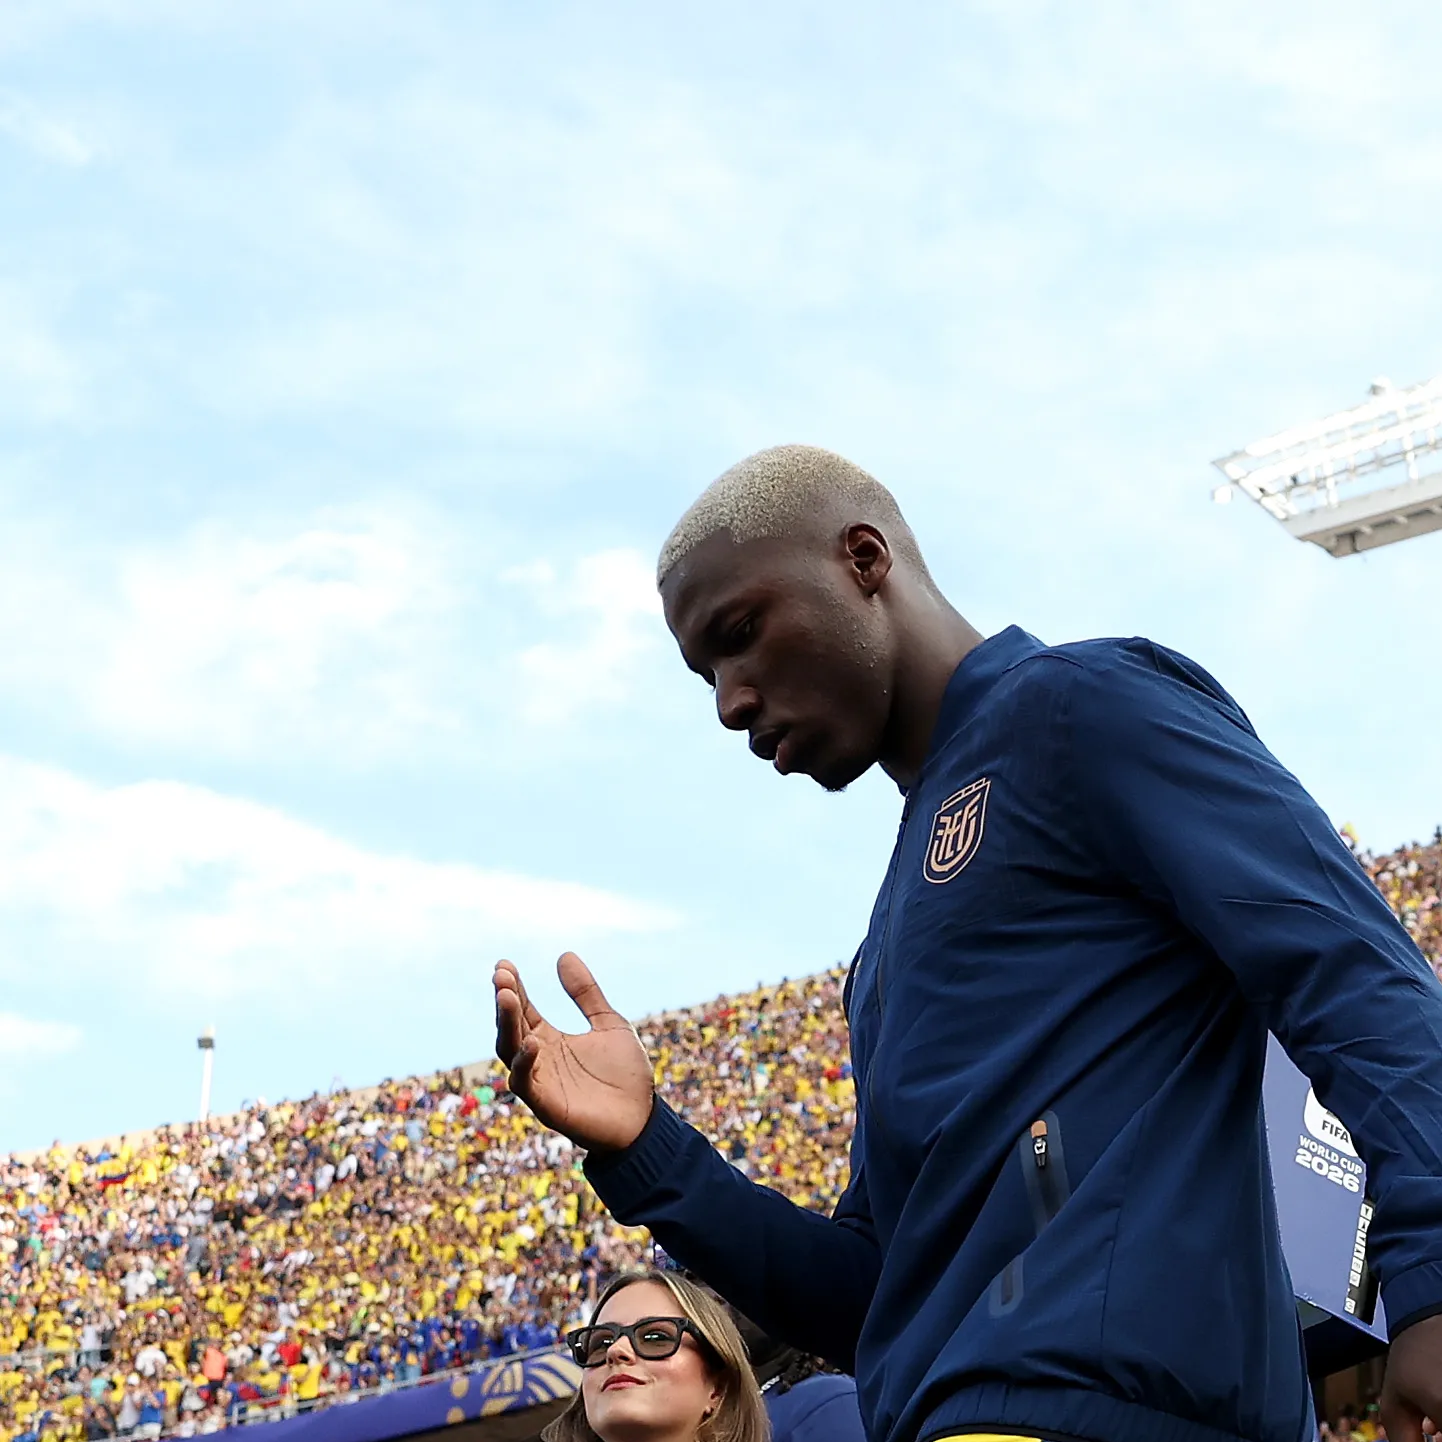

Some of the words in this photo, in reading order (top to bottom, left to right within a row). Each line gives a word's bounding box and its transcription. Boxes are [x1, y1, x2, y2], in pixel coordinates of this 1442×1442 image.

[1322, 1120, 1350, 1143] FIFA
[1295, 1147, 1360, 1193] 2026
[1299, 1135, 1340, 1164] WORLD
[1340, 1157, 1363, 1175] CUP
